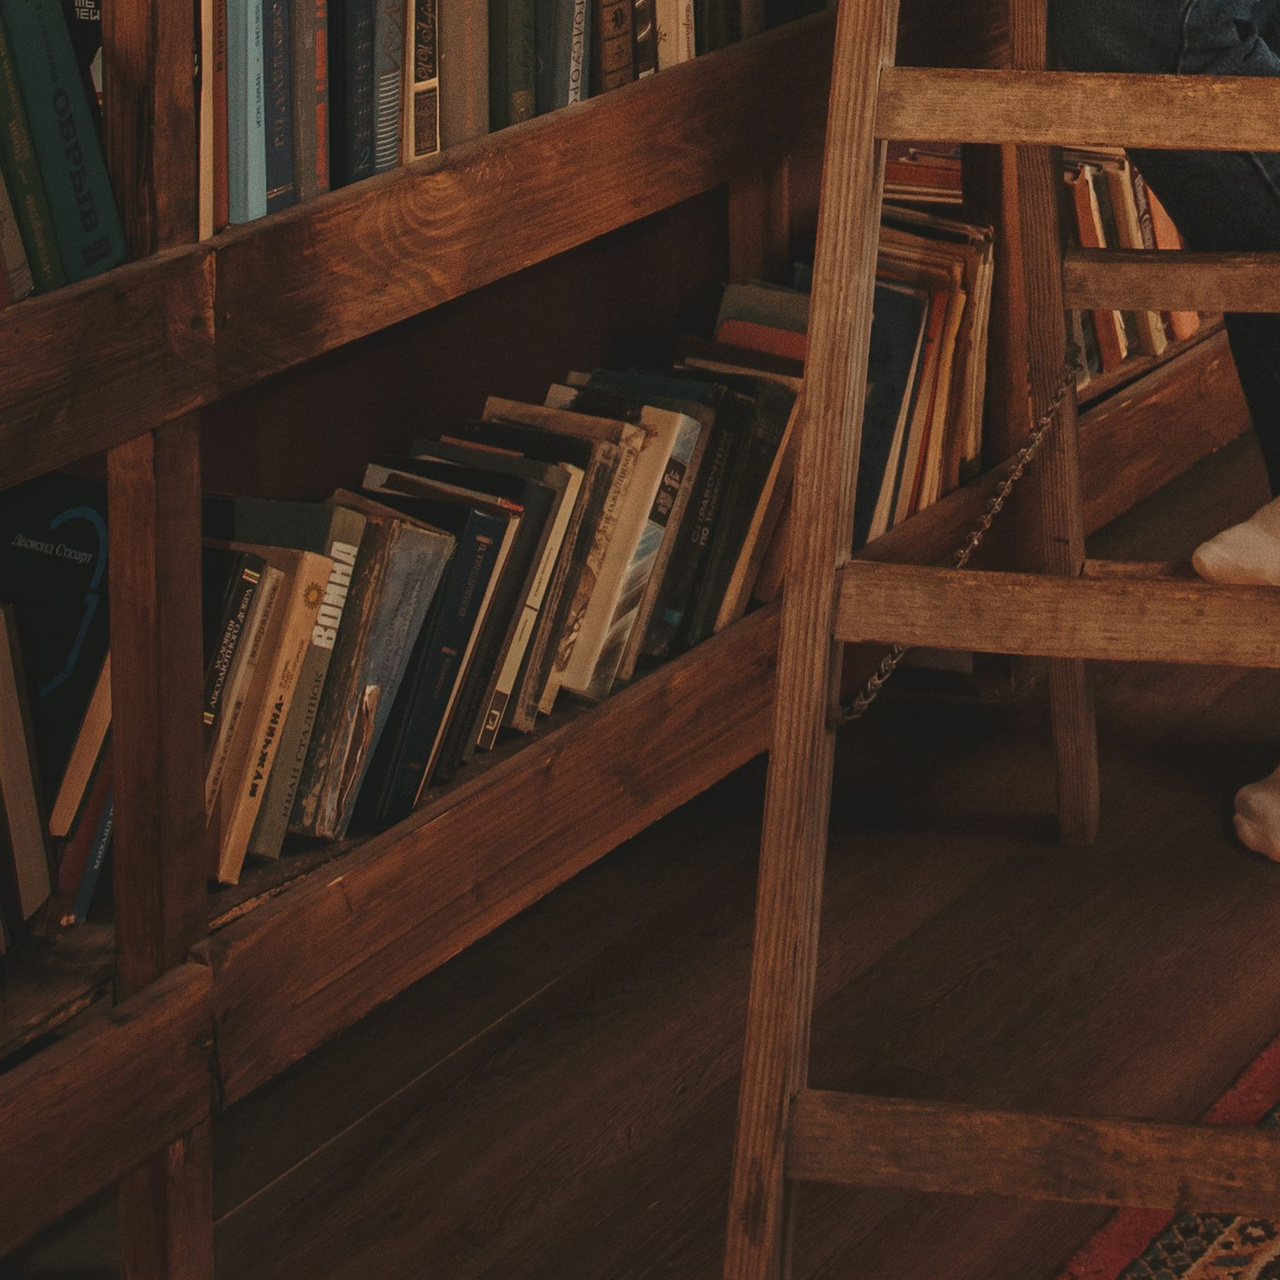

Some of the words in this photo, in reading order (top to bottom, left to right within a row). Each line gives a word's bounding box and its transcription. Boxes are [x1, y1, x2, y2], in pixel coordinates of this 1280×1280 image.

[49, 85, 100, 235] ОБРЫВ
[690, 428, 730, 544] СПРАВОЧНИК
[10, 532, 55, 554] Десмонд
[54, 543, 92, 565] Стюарт
[698, 526, 709, 546] ПО
[208, 622, 241, 708] АБСОЛЮТНОГО
[236, 586, 253, 622] ДОБРА
[214, 619, 236, 670] УСЛОВИЯ
[281, 766, 299, 818] ИВАН
[294, 670, 324, 762] СТАДНЮК
[92, 819, 113, 870] МИХАИЛ
